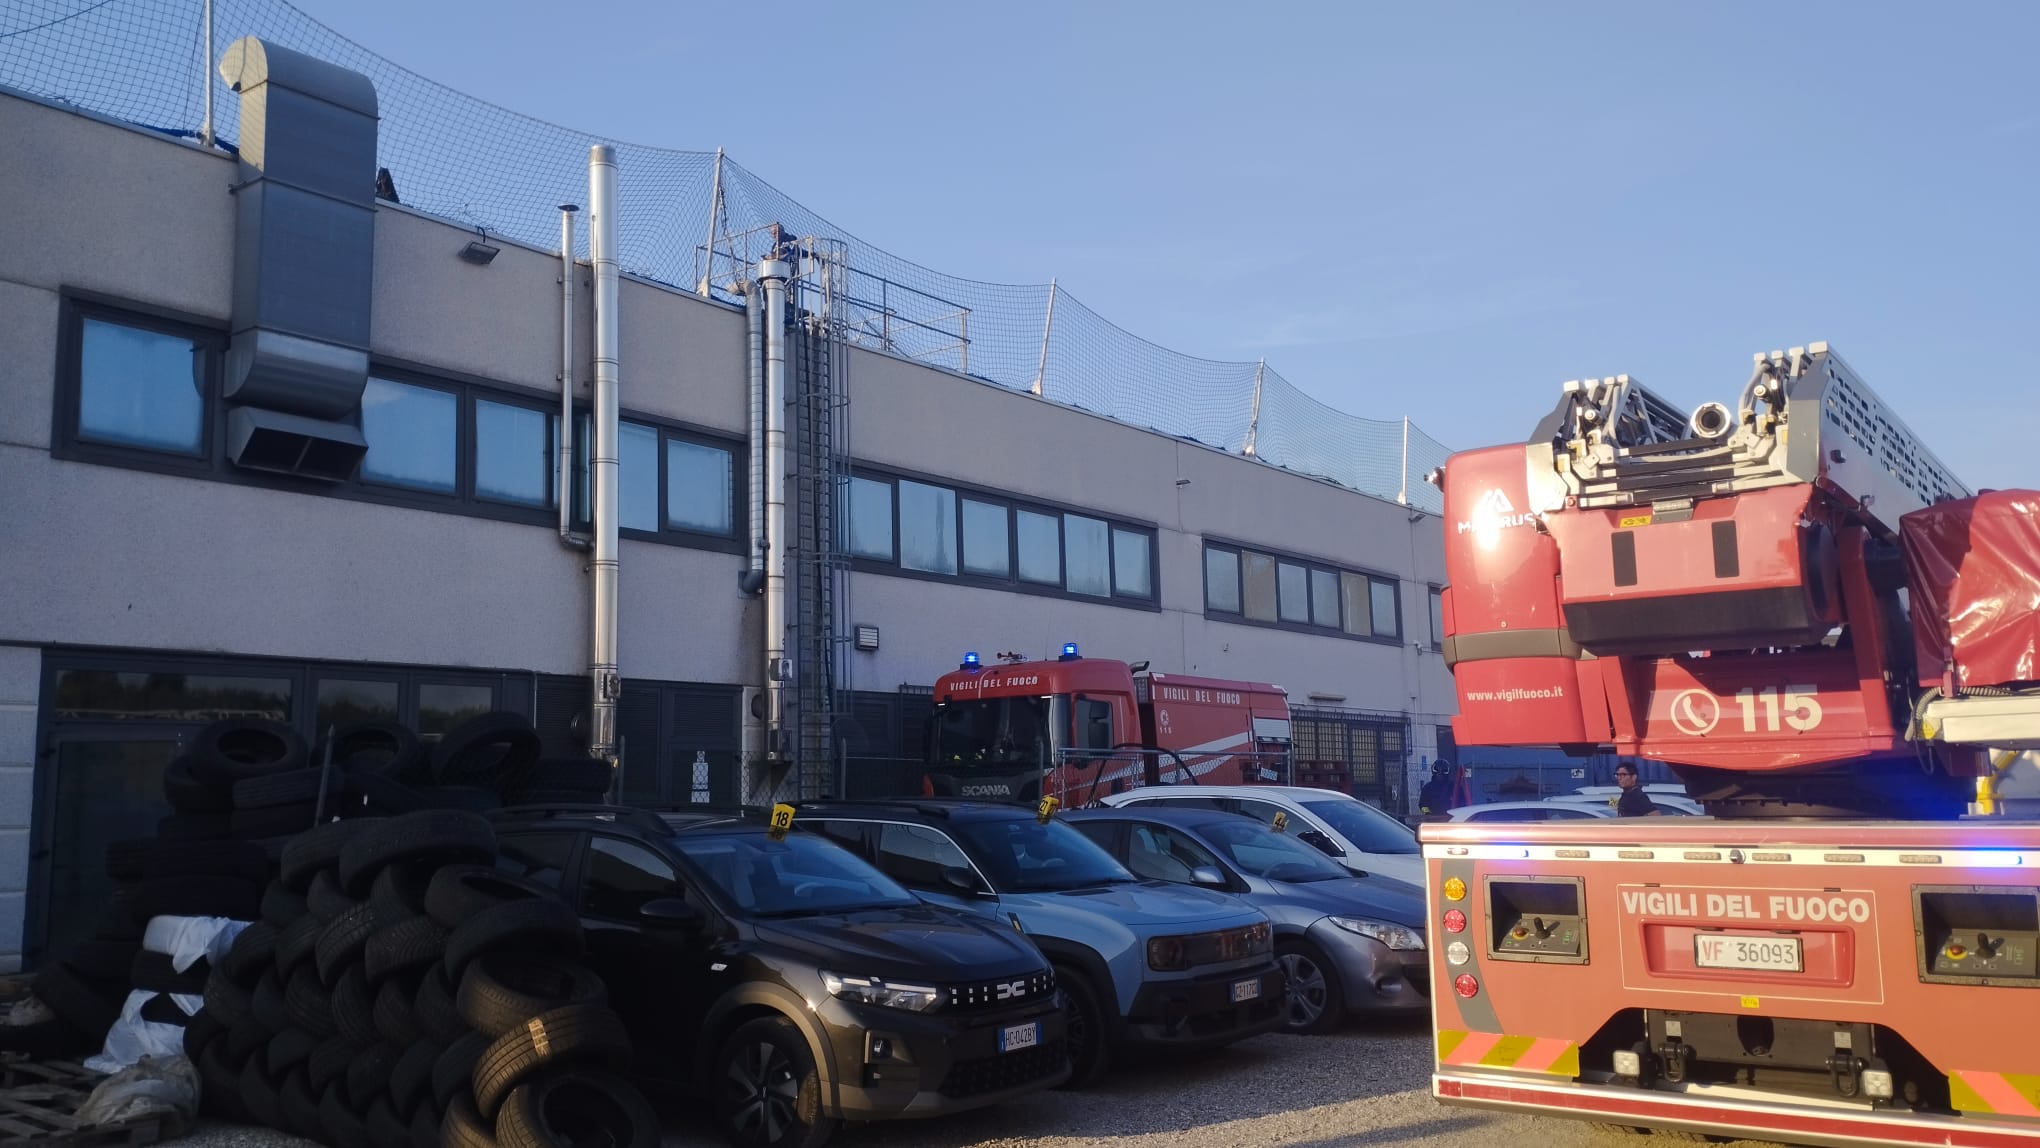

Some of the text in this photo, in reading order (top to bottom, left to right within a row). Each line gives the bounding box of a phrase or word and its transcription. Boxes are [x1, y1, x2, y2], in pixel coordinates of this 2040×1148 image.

[950, 676, 1038, 691] VIGILI DEL FUOCO
[1163, 687, 1240, 704] VIGILI DEL FUOCO
[1467, 686, 1564, 702] www.vigilfuoco.it
[1736, 684, 1823, 732] 115
[961, 784, 1011, 797] SCANIA
[776, 811, 789, 826] 18
[1622, 891, 1870, 923] VIGILI DEL FUOCO
[1702, 939, 1795, 965] VF 36093
